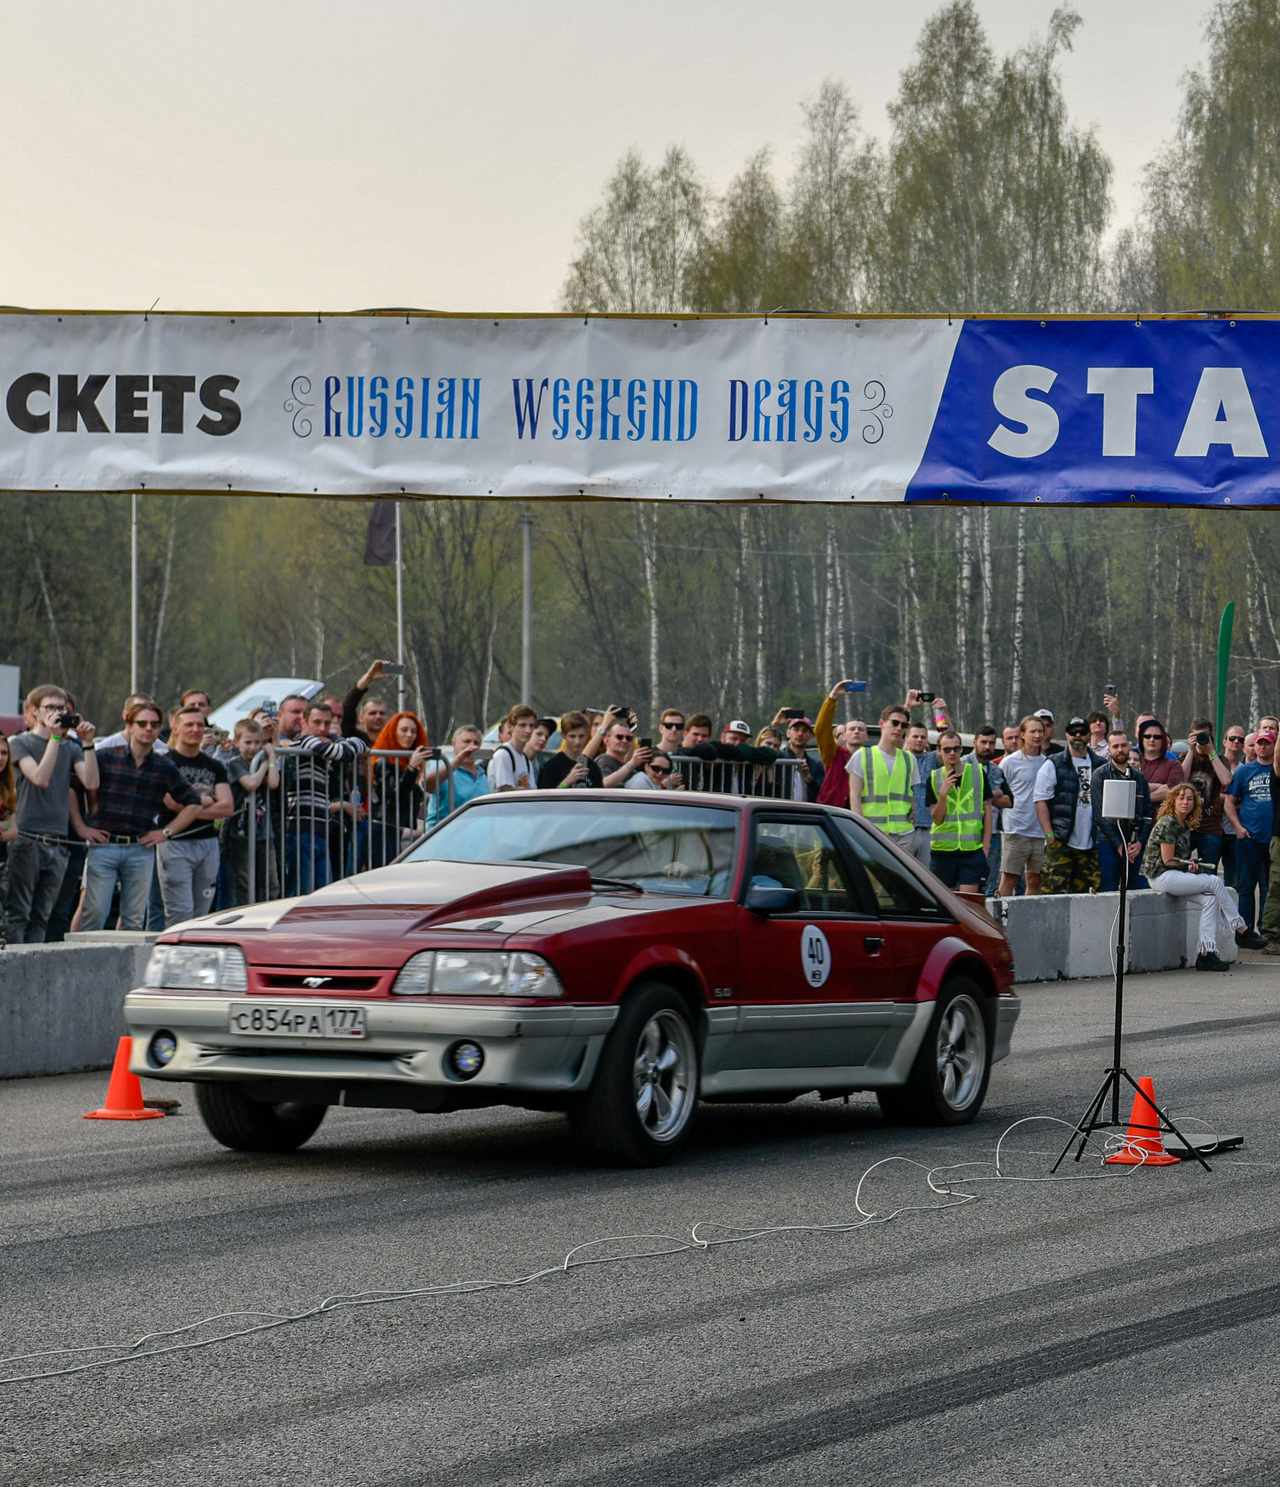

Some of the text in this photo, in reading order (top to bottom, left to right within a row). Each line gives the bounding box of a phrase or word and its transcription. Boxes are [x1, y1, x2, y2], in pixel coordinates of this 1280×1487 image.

[6, 372, 242, 437] CKETS
[324, 375, 852, 444] RUSSIAN WEEKEND DRAGS
[807, 937, 824, 965] 40
